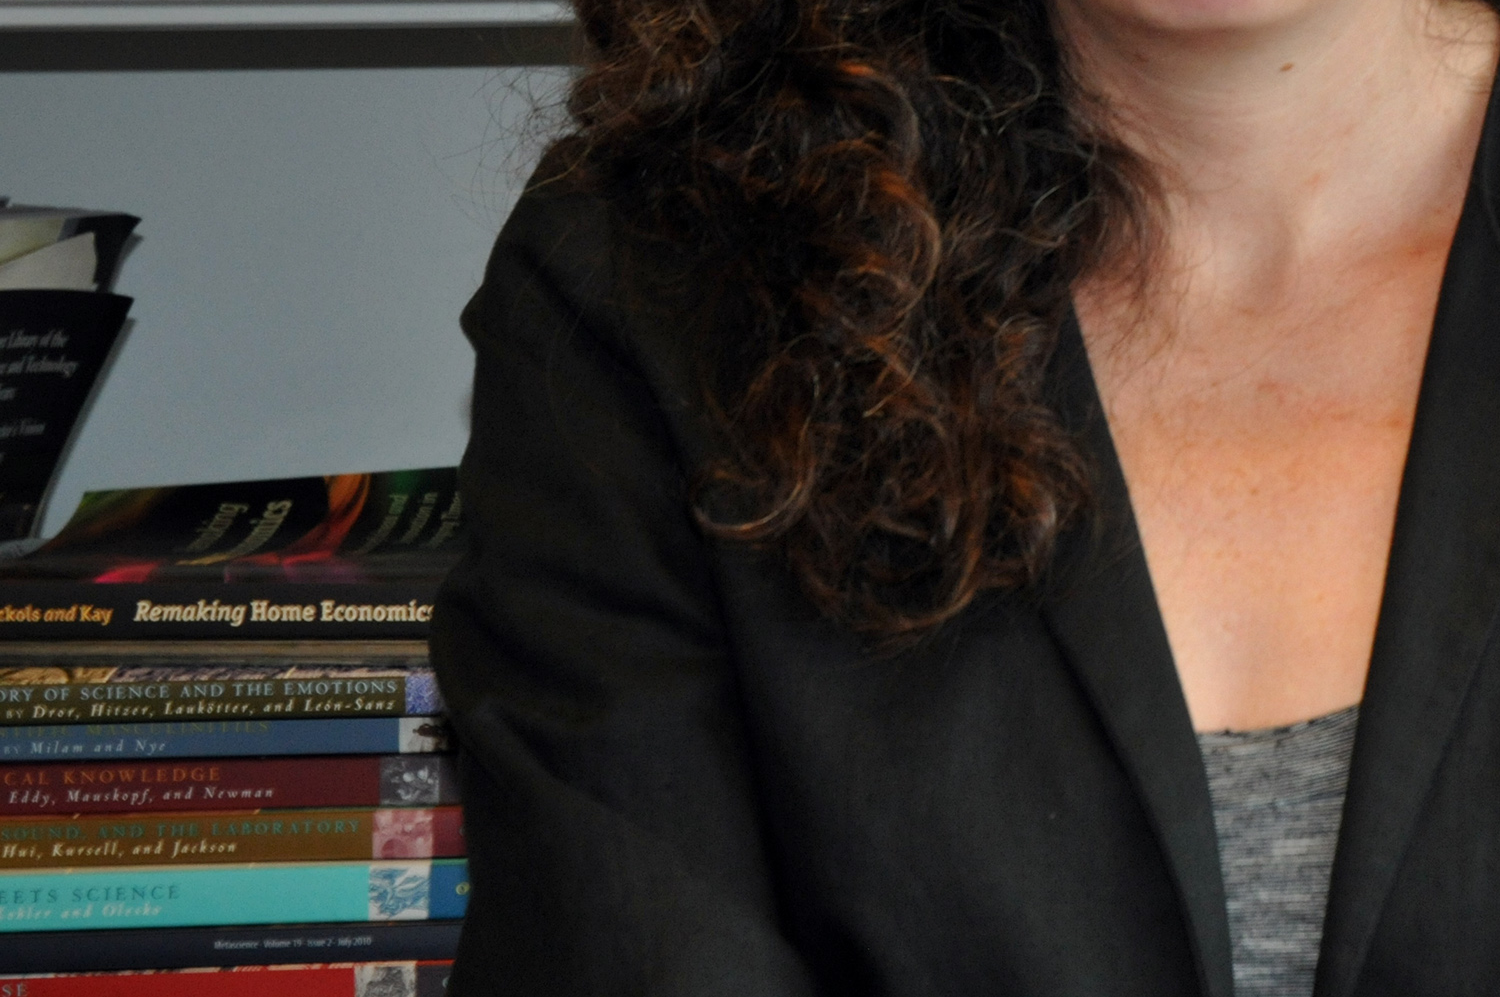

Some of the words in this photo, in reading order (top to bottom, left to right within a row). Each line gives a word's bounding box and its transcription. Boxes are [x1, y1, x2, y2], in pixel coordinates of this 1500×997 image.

[44, 604, 78, 622] and
[80, 604, 114, 626] Kay
[134, 600, 245, 627] Remaking
[250, 600, 315, 622] Home
[44, 688, 70, 702] OF
[80, 684, 169, 700] SCIENCE
[180, 683, 224, 698] AND
[233, 682, 275, 697] THE
[283, 680, 396, 696] EMOTIONS
[6, 710, 23, 719] BY
[33, 705, 80, 721] Dror,
[90, 703, 155, 719] Hitzer,
[164, 700, 257, 717] Laukötter,
[263, 699, 294, 713] and
[304, 697, 396, 712] León-Sanz
[30, 741, 83, 754] Milam
[94, 739, 124, 753] and
[135, 739, 167, 756] Nye
[64, 767, 221, 784] KNOWLEDGE
[9, 790, 56, 807] Eddy,
[66, 787, 155, 806] Mauskopf,
[162, 785, 193, 800] and
[203, 785, 274, 800] Newman
[97, 824, 144, 838] AND
[156, 822, 199, 836] THE
[211, 820, 361, 836] LABORATORY
[2, 843, 43, 860] Hui,
[52, 841, 125, 858] Kursell,
[133, 840, 163, 855] and
[170, 839, 237, 858] Jackson
[72, 885, 180, 902] SCIENCE
[60, 904, 93, 919] and
[214, 939, 258, 950] Metascience
[263, 939, 291, 949] Volume
[307, 938, 326, 948] Issue
[337, 937, 352, 948] July
[353, 936, 372, 946] 2010
